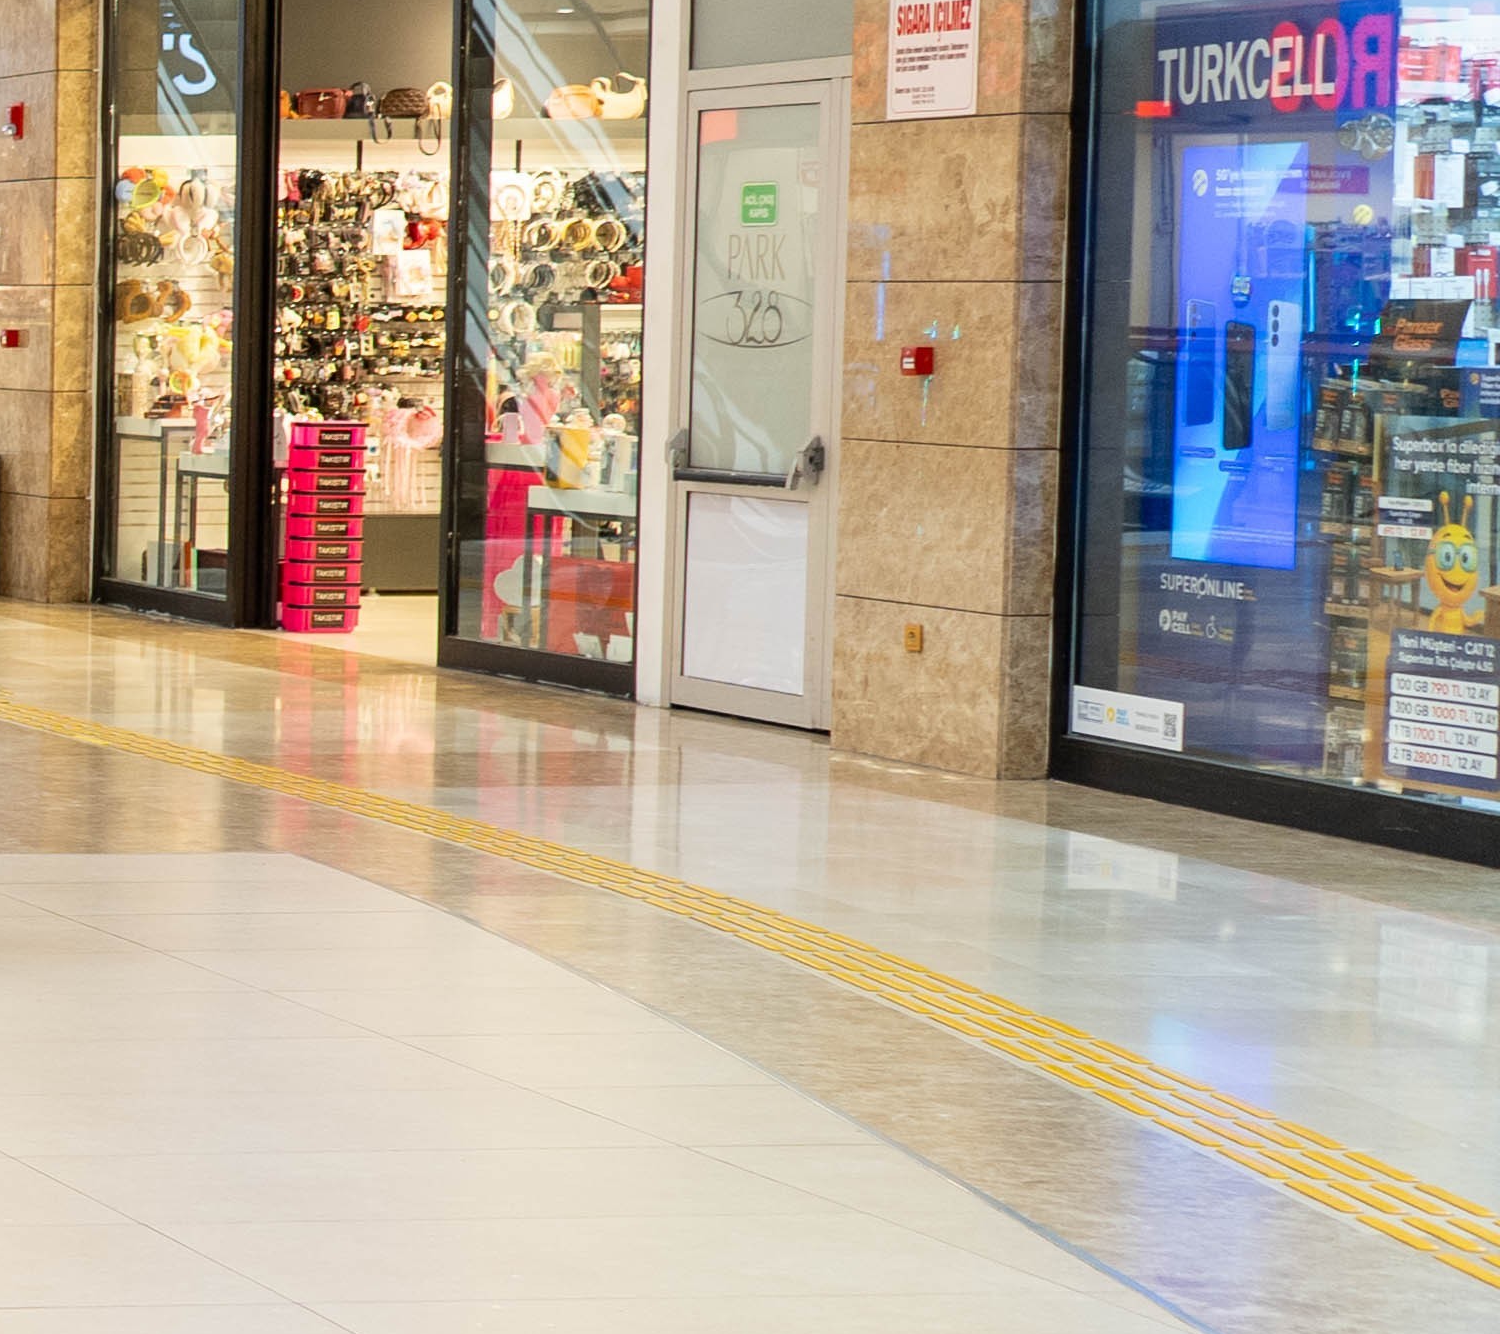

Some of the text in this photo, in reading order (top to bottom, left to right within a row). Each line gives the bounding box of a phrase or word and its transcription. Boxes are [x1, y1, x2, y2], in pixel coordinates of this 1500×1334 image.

[1158, 34, 1335, 107] TURKCELL
[728, 234, 786, 280] PARK
[726, 290, 783, 345] 328
[1414, 459, 1445, 475] yerde
[1447, 458, 1471, 474] fiber
[1413, 680, 1428, 693] GB
[1414, 704, 1429, 717] GB
